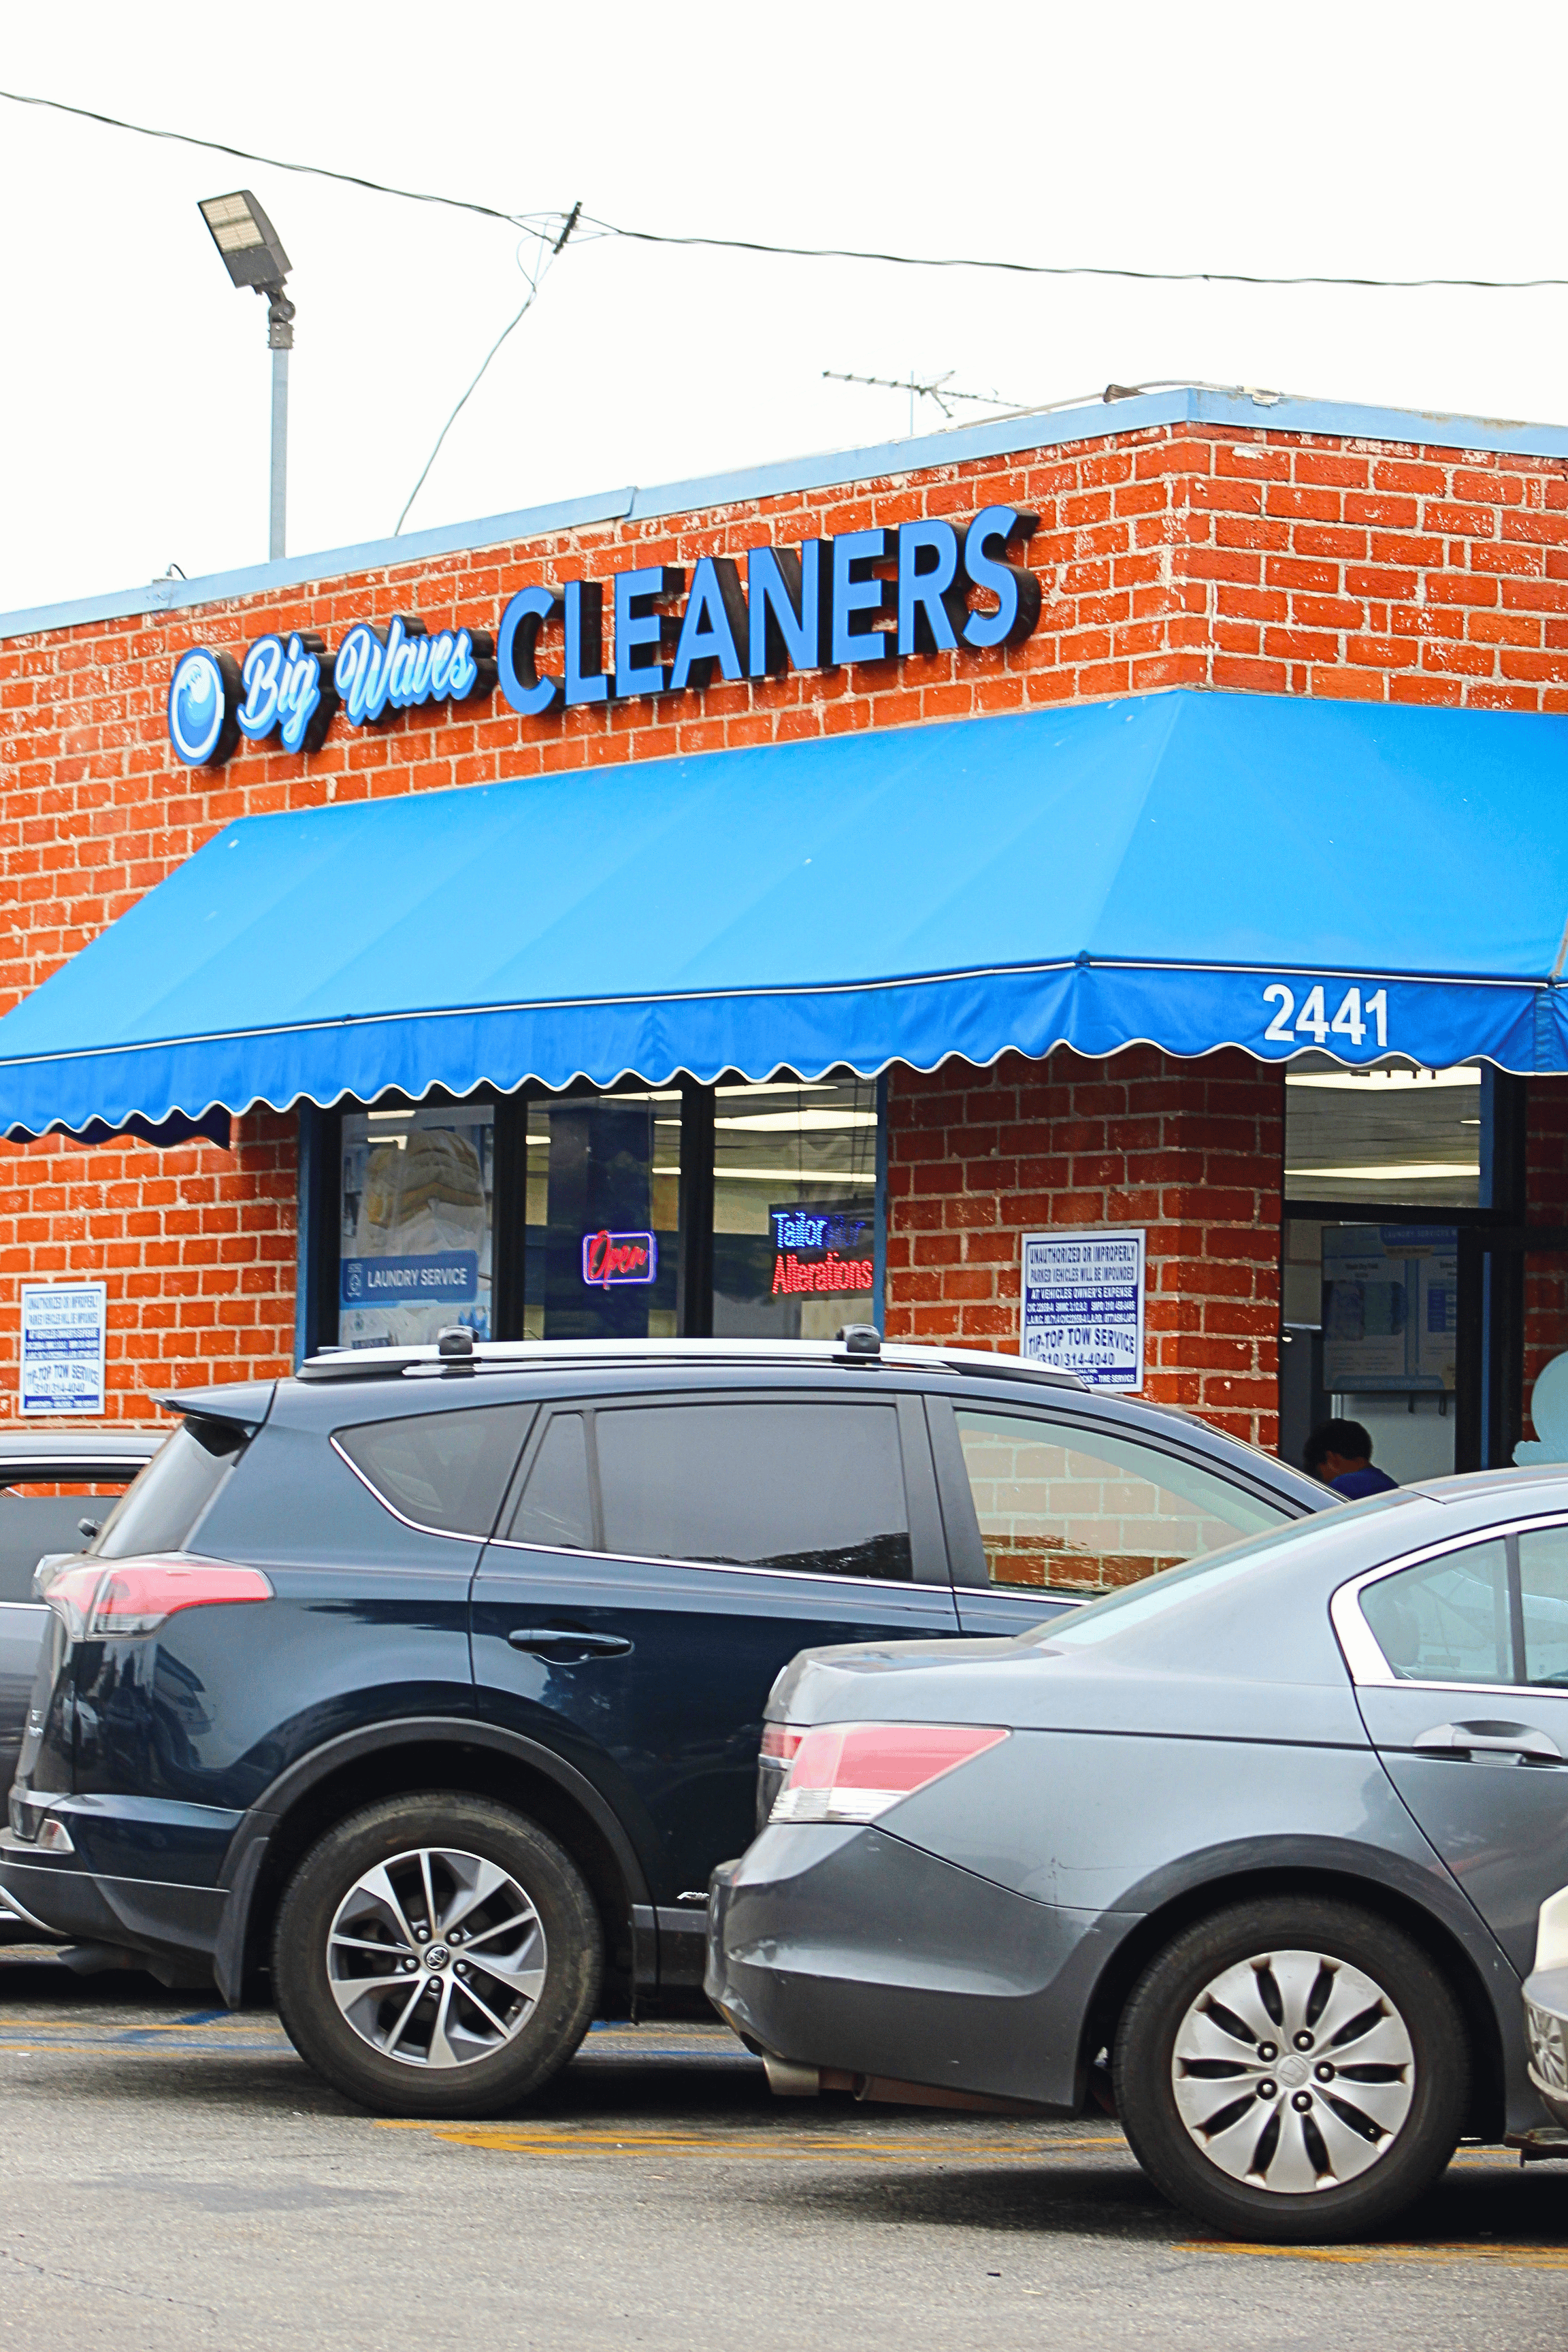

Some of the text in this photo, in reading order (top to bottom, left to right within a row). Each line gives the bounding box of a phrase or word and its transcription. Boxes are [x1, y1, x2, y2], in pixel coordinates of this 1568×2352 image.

[236, 505, 1022, 753] Big Waves CLEANERS
[1263, 983, 1388, 1047] 2441
[772, 1211, 828, 1249] Tailor
[588, 1230, 647, 1290] Open
[1029, 1245, 1135, 1264] UNAUTHORIZED OR IMPROPERLY
[368, 1267, 468, 1288] LAUNDRY SERVICE
[772, 1251, 874, 1294] Alterations
[1052, 1267, 1079, 1283] VEHICLES
[1080, 1267, 1093, 1282] WILL
[1094, 1267, 1101, 1281] BE
[1102, 1266, 1134, 1281] IMPOUNDED
[1031, 1288, 1040, 1299] AT
[1103, 1286, 1134, 1298] EXPENSE
[1028, 1327, 1135, 1356] TIP-TOP TOW SERVICE
